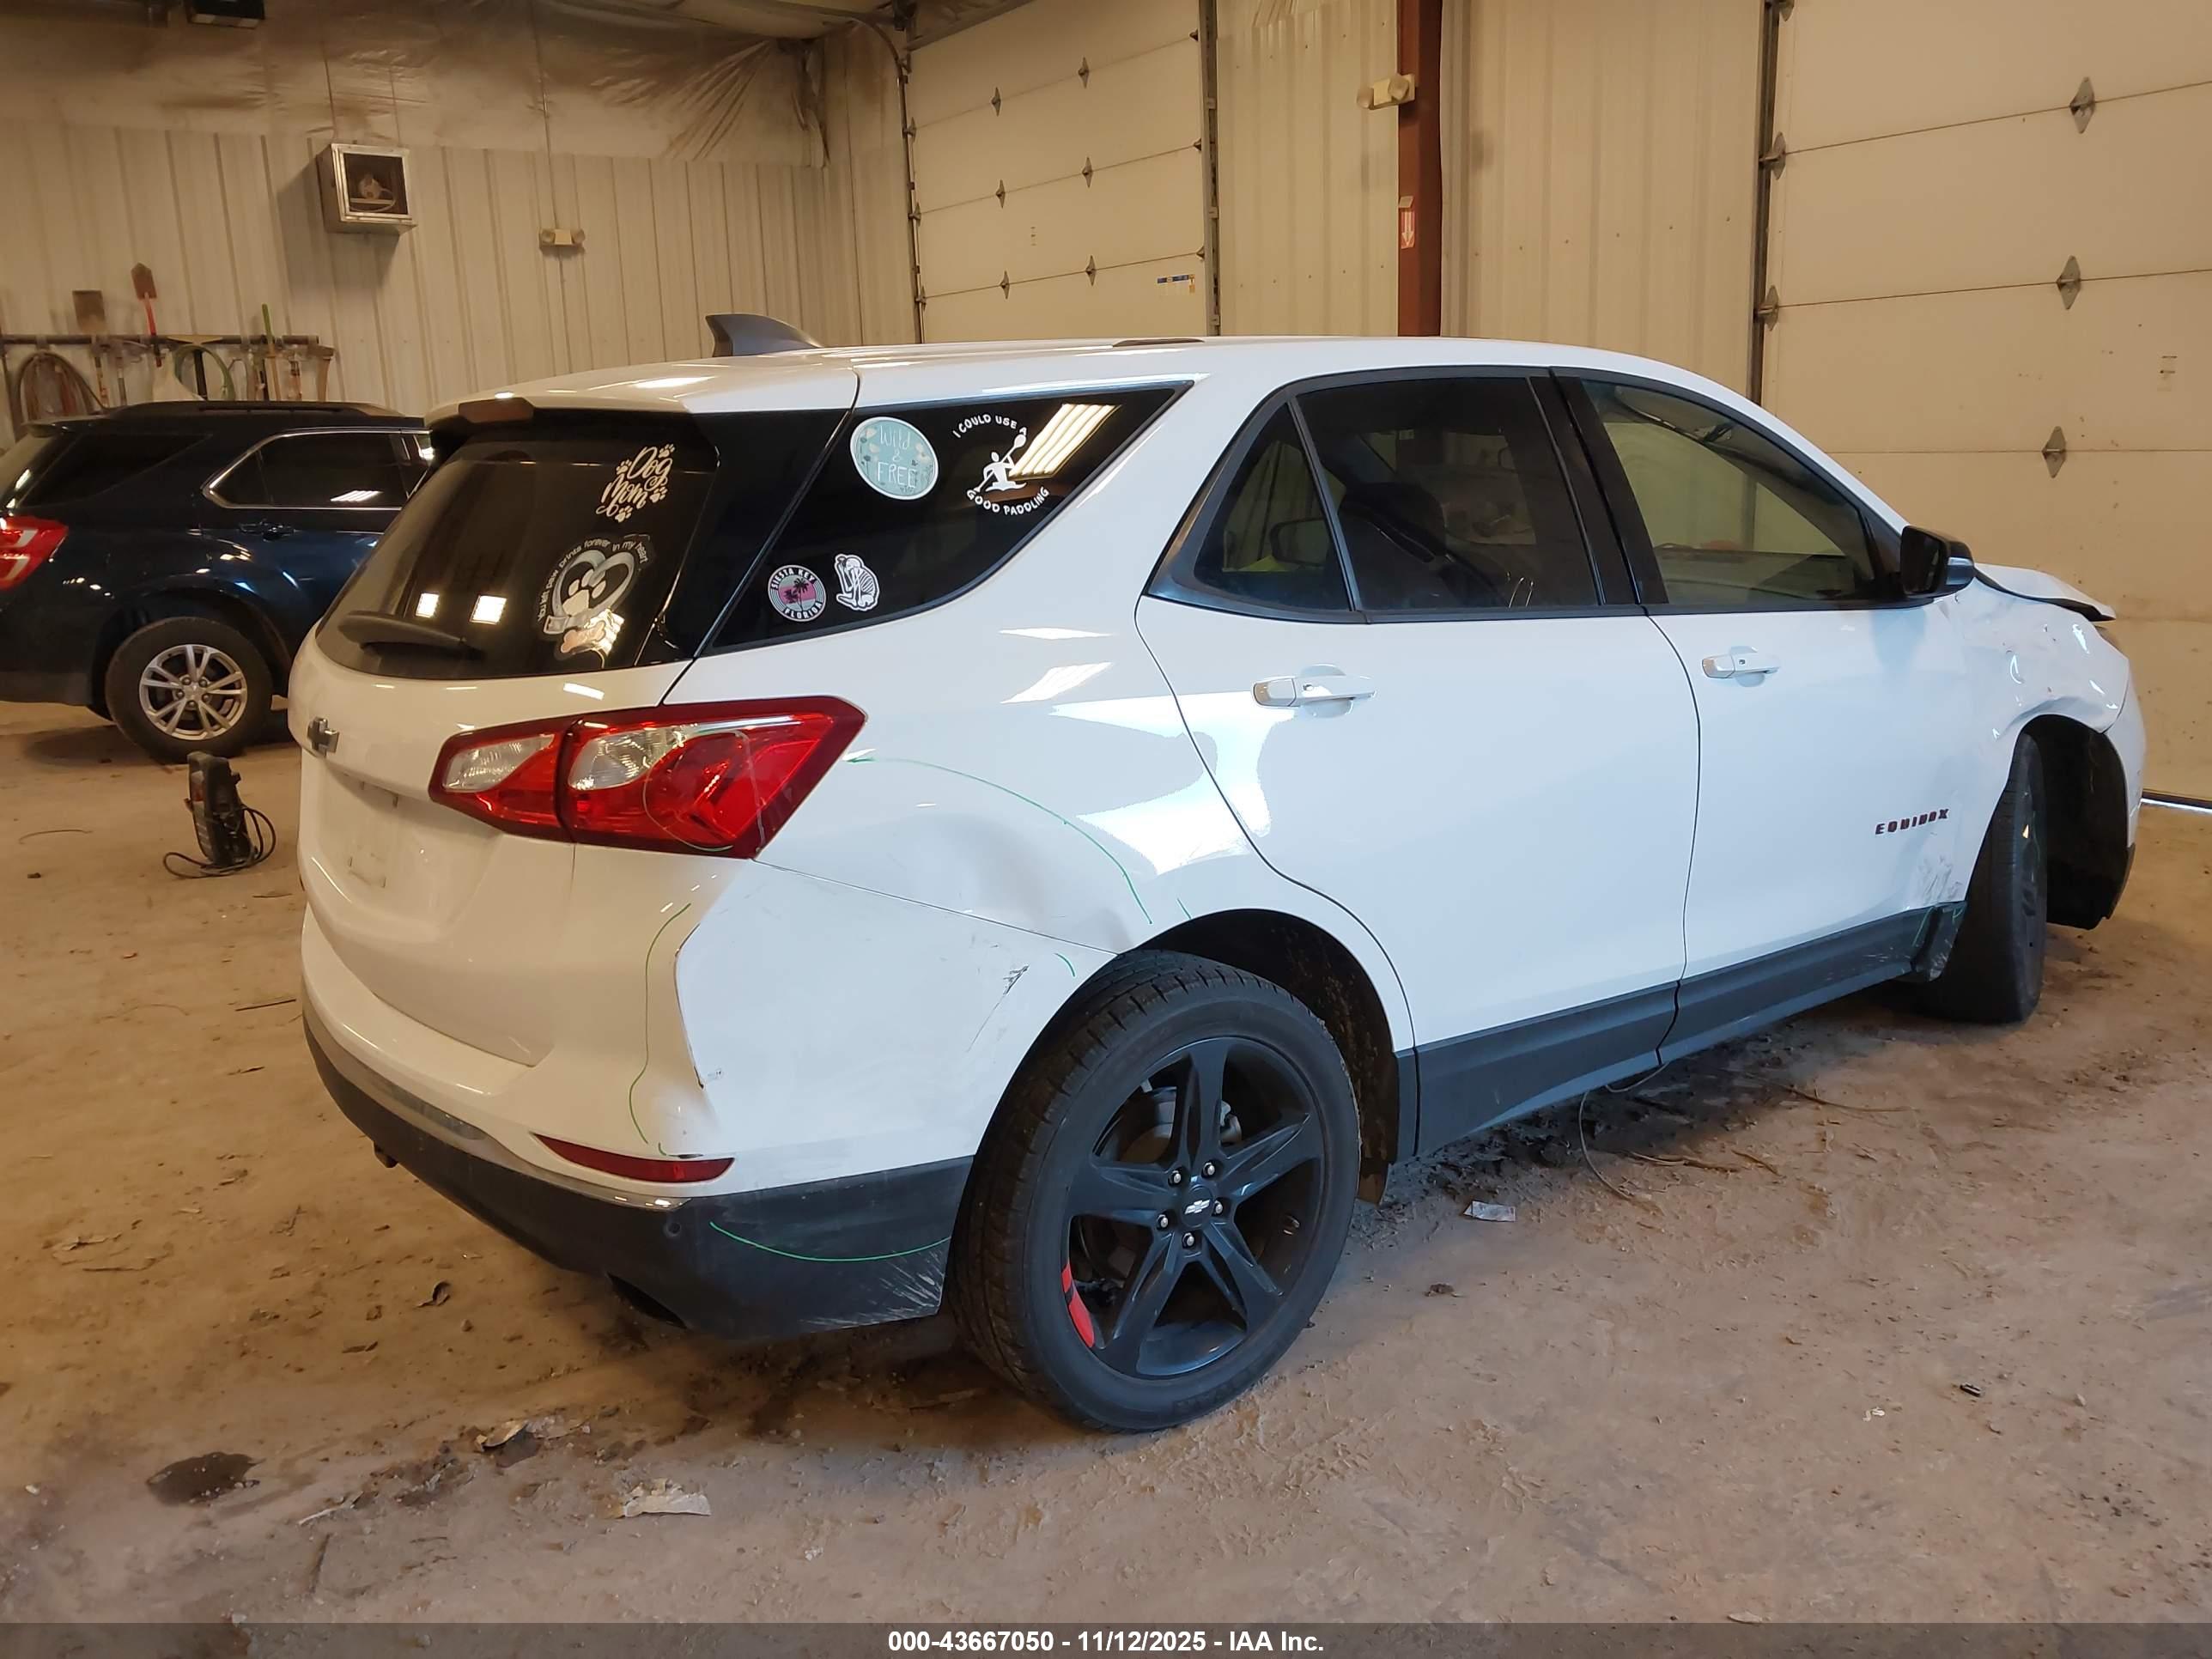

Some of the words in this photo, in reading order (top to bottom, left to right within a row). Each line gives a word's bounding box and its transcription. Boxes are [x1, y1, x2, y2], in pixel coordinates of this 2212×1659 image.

[880, 425, 911, 450] Wild
[952, 430, 961, 439] I
[958, 414, 992, 433] COULD
[995, 415, 1018, 429] USE
[1018, 427, 1027, 436] A
[626, 446, 673, 492] Dog
[877, 461, 918, 489] FREE
[595, 473, 649, 517] Mom
[966, 489, 1000, 513] GOOD
[1003, 486, 1050, 516] PADDLING
[545, 569, 558, 589] paw
[558, 546, 582, 568] prints
[584, 538, 611, 549] forever
[612, 543, 621, 552] in
[622, 540, 636, 550] my
[635, 541, 649, 564] heart
[770, 568, 795, 589] SIESTA
[798, 568, 816, 581] KEY
[784, 601, 823, 619] FLORIDA
[1875, 808, 1950, 836] EQUINOX
